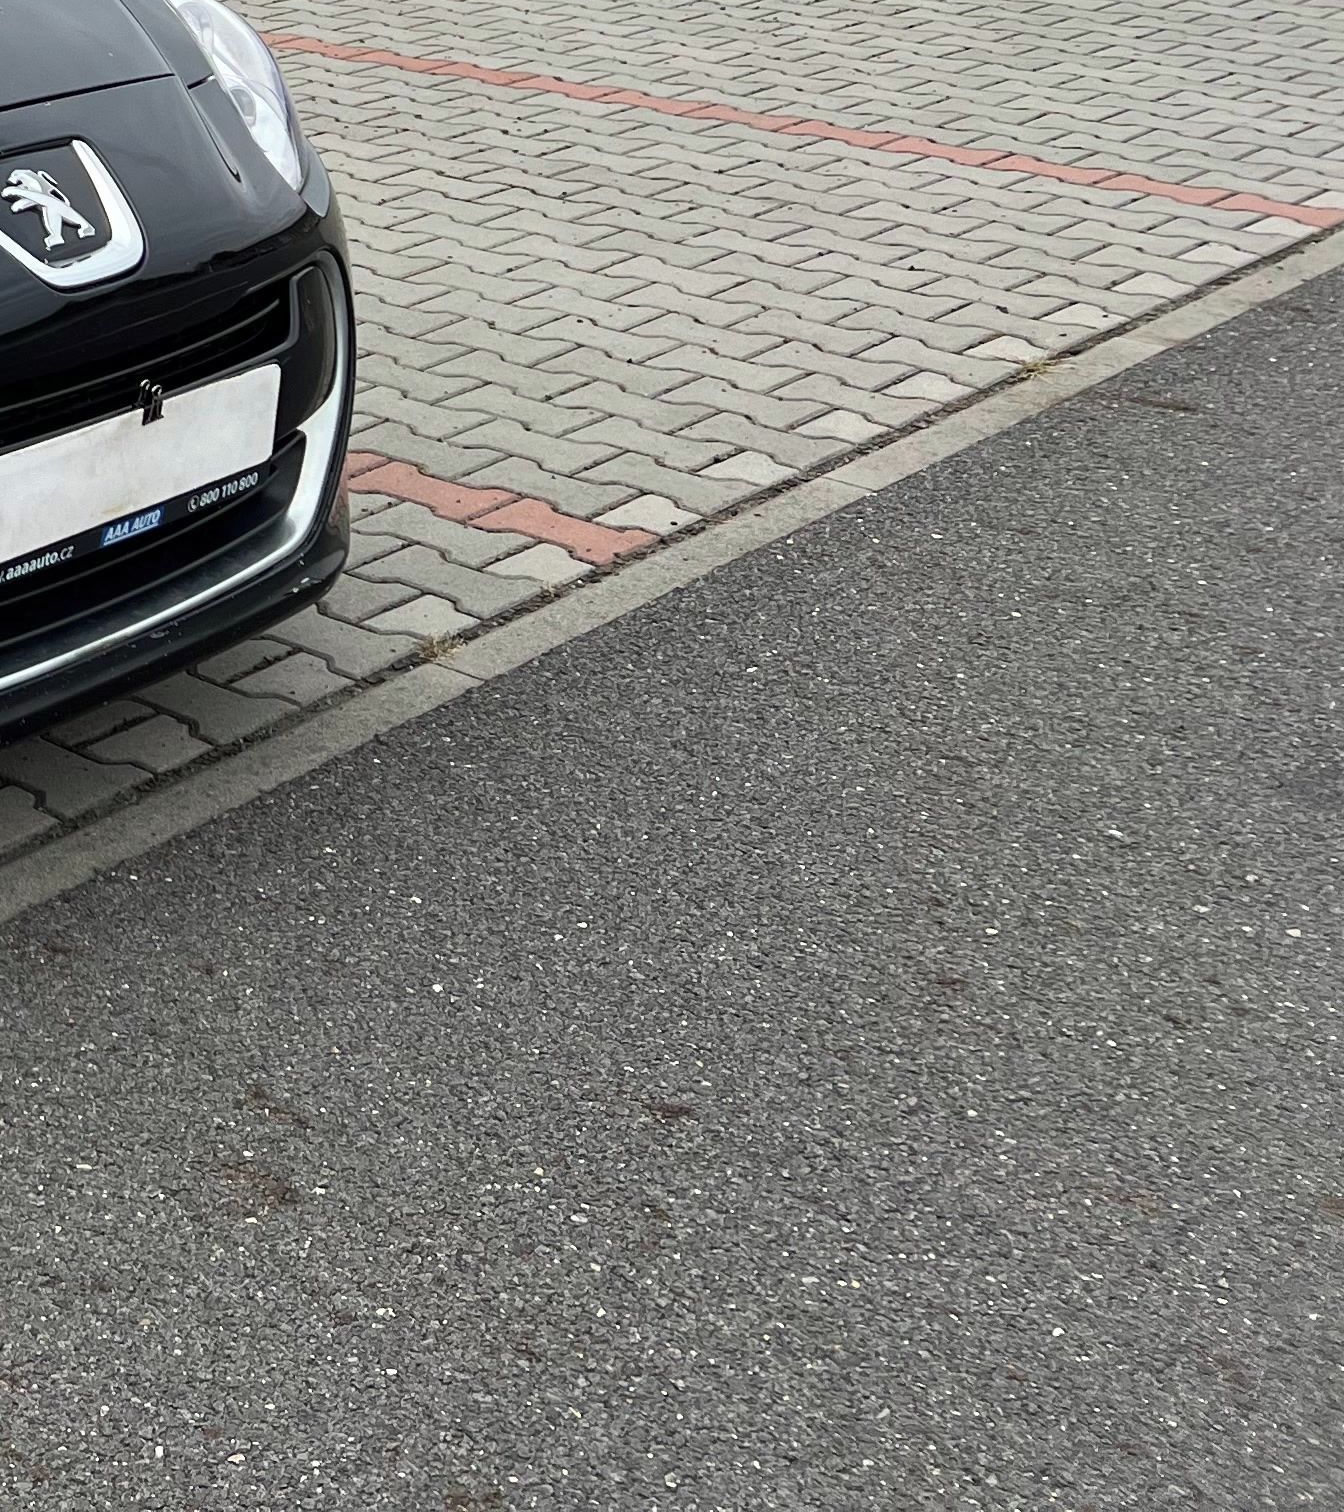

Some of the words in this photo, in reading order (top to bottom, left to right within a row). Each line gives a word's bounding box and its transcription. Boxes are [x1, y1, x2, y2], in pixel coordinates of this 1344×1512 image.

[199, 488, 220, 508] 800
[221, 481, 240, 500] 110
[239, 471, 259, 491] 800
[103, 519, 130, 543] AAA
[130, 508, 162, 531] AUTO
